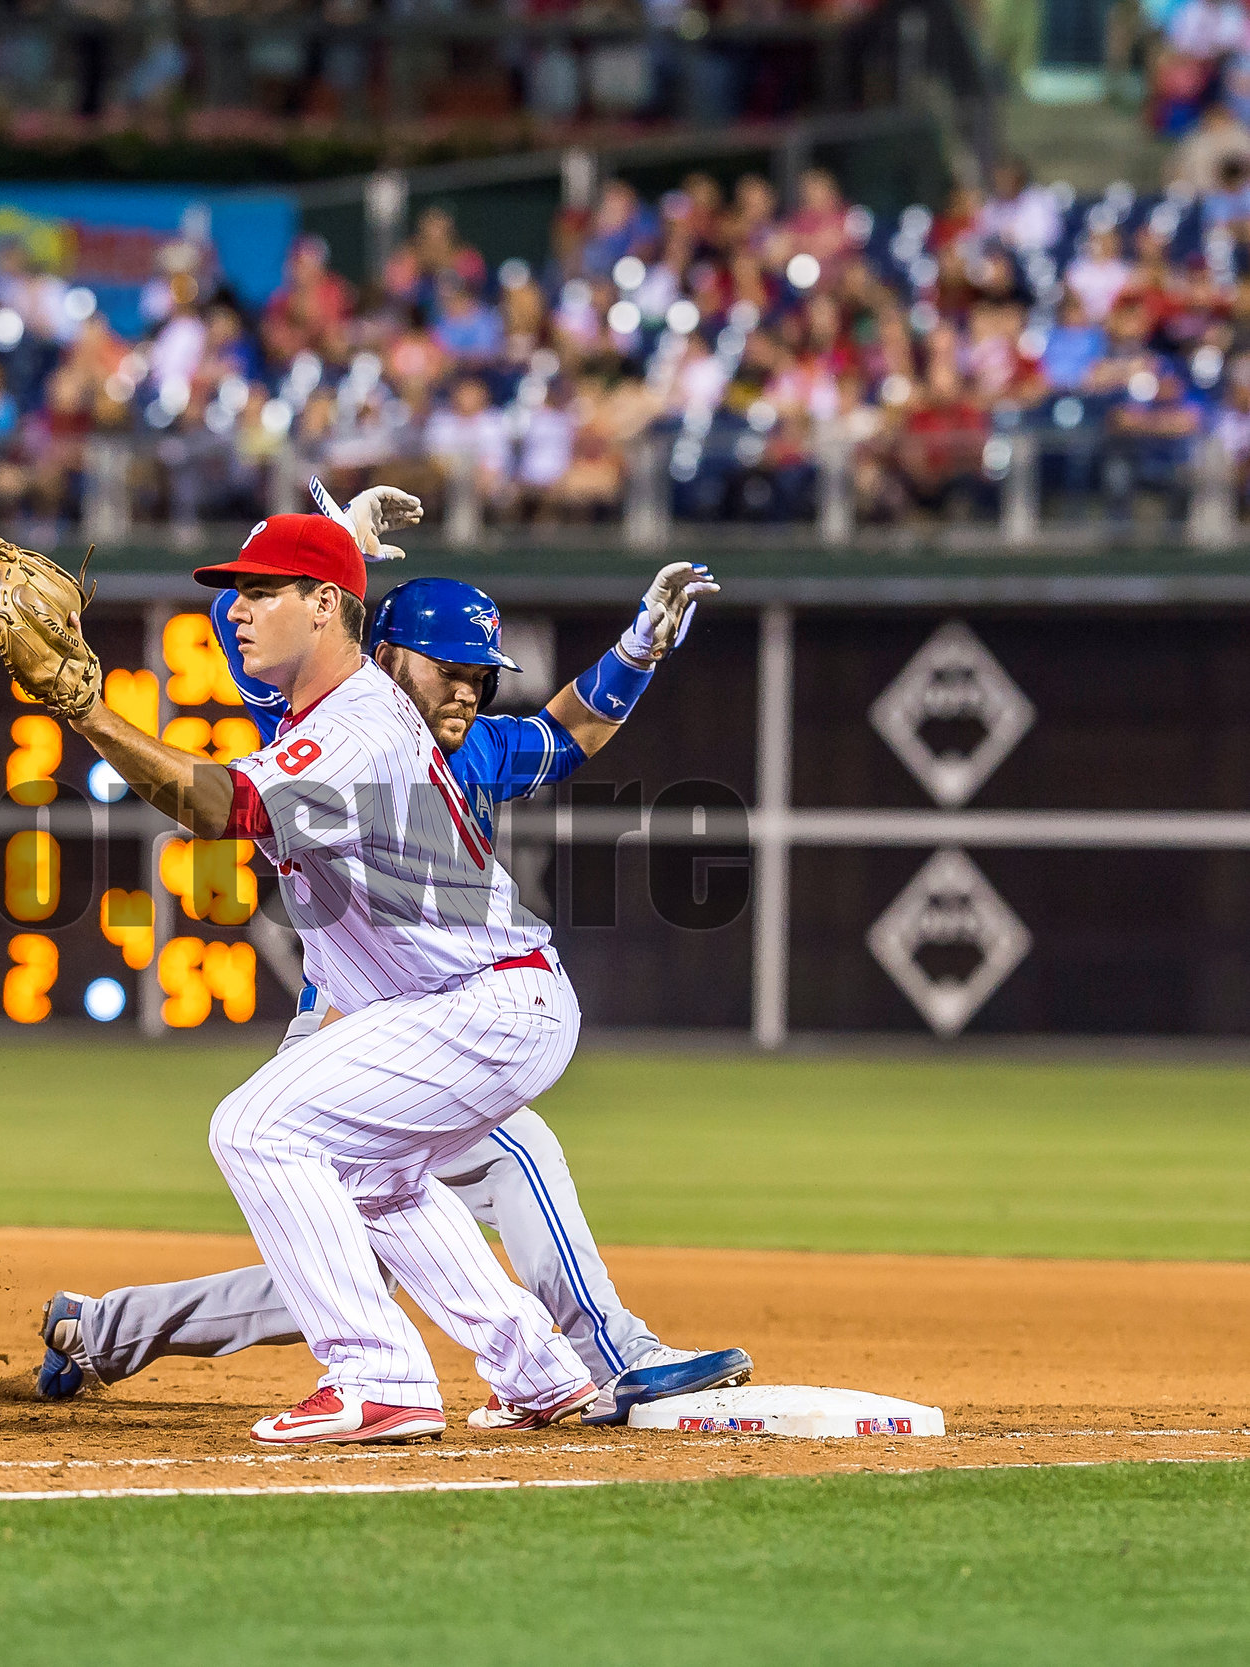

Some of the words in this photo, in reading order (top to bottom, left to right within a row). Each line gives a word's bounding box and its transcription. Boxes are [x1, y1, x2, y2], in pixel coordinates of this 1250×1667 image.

[6, 714, 64, 807] 2
[3, 932, 60, 1025] 2
[157, 935, 257, 1029] 54
